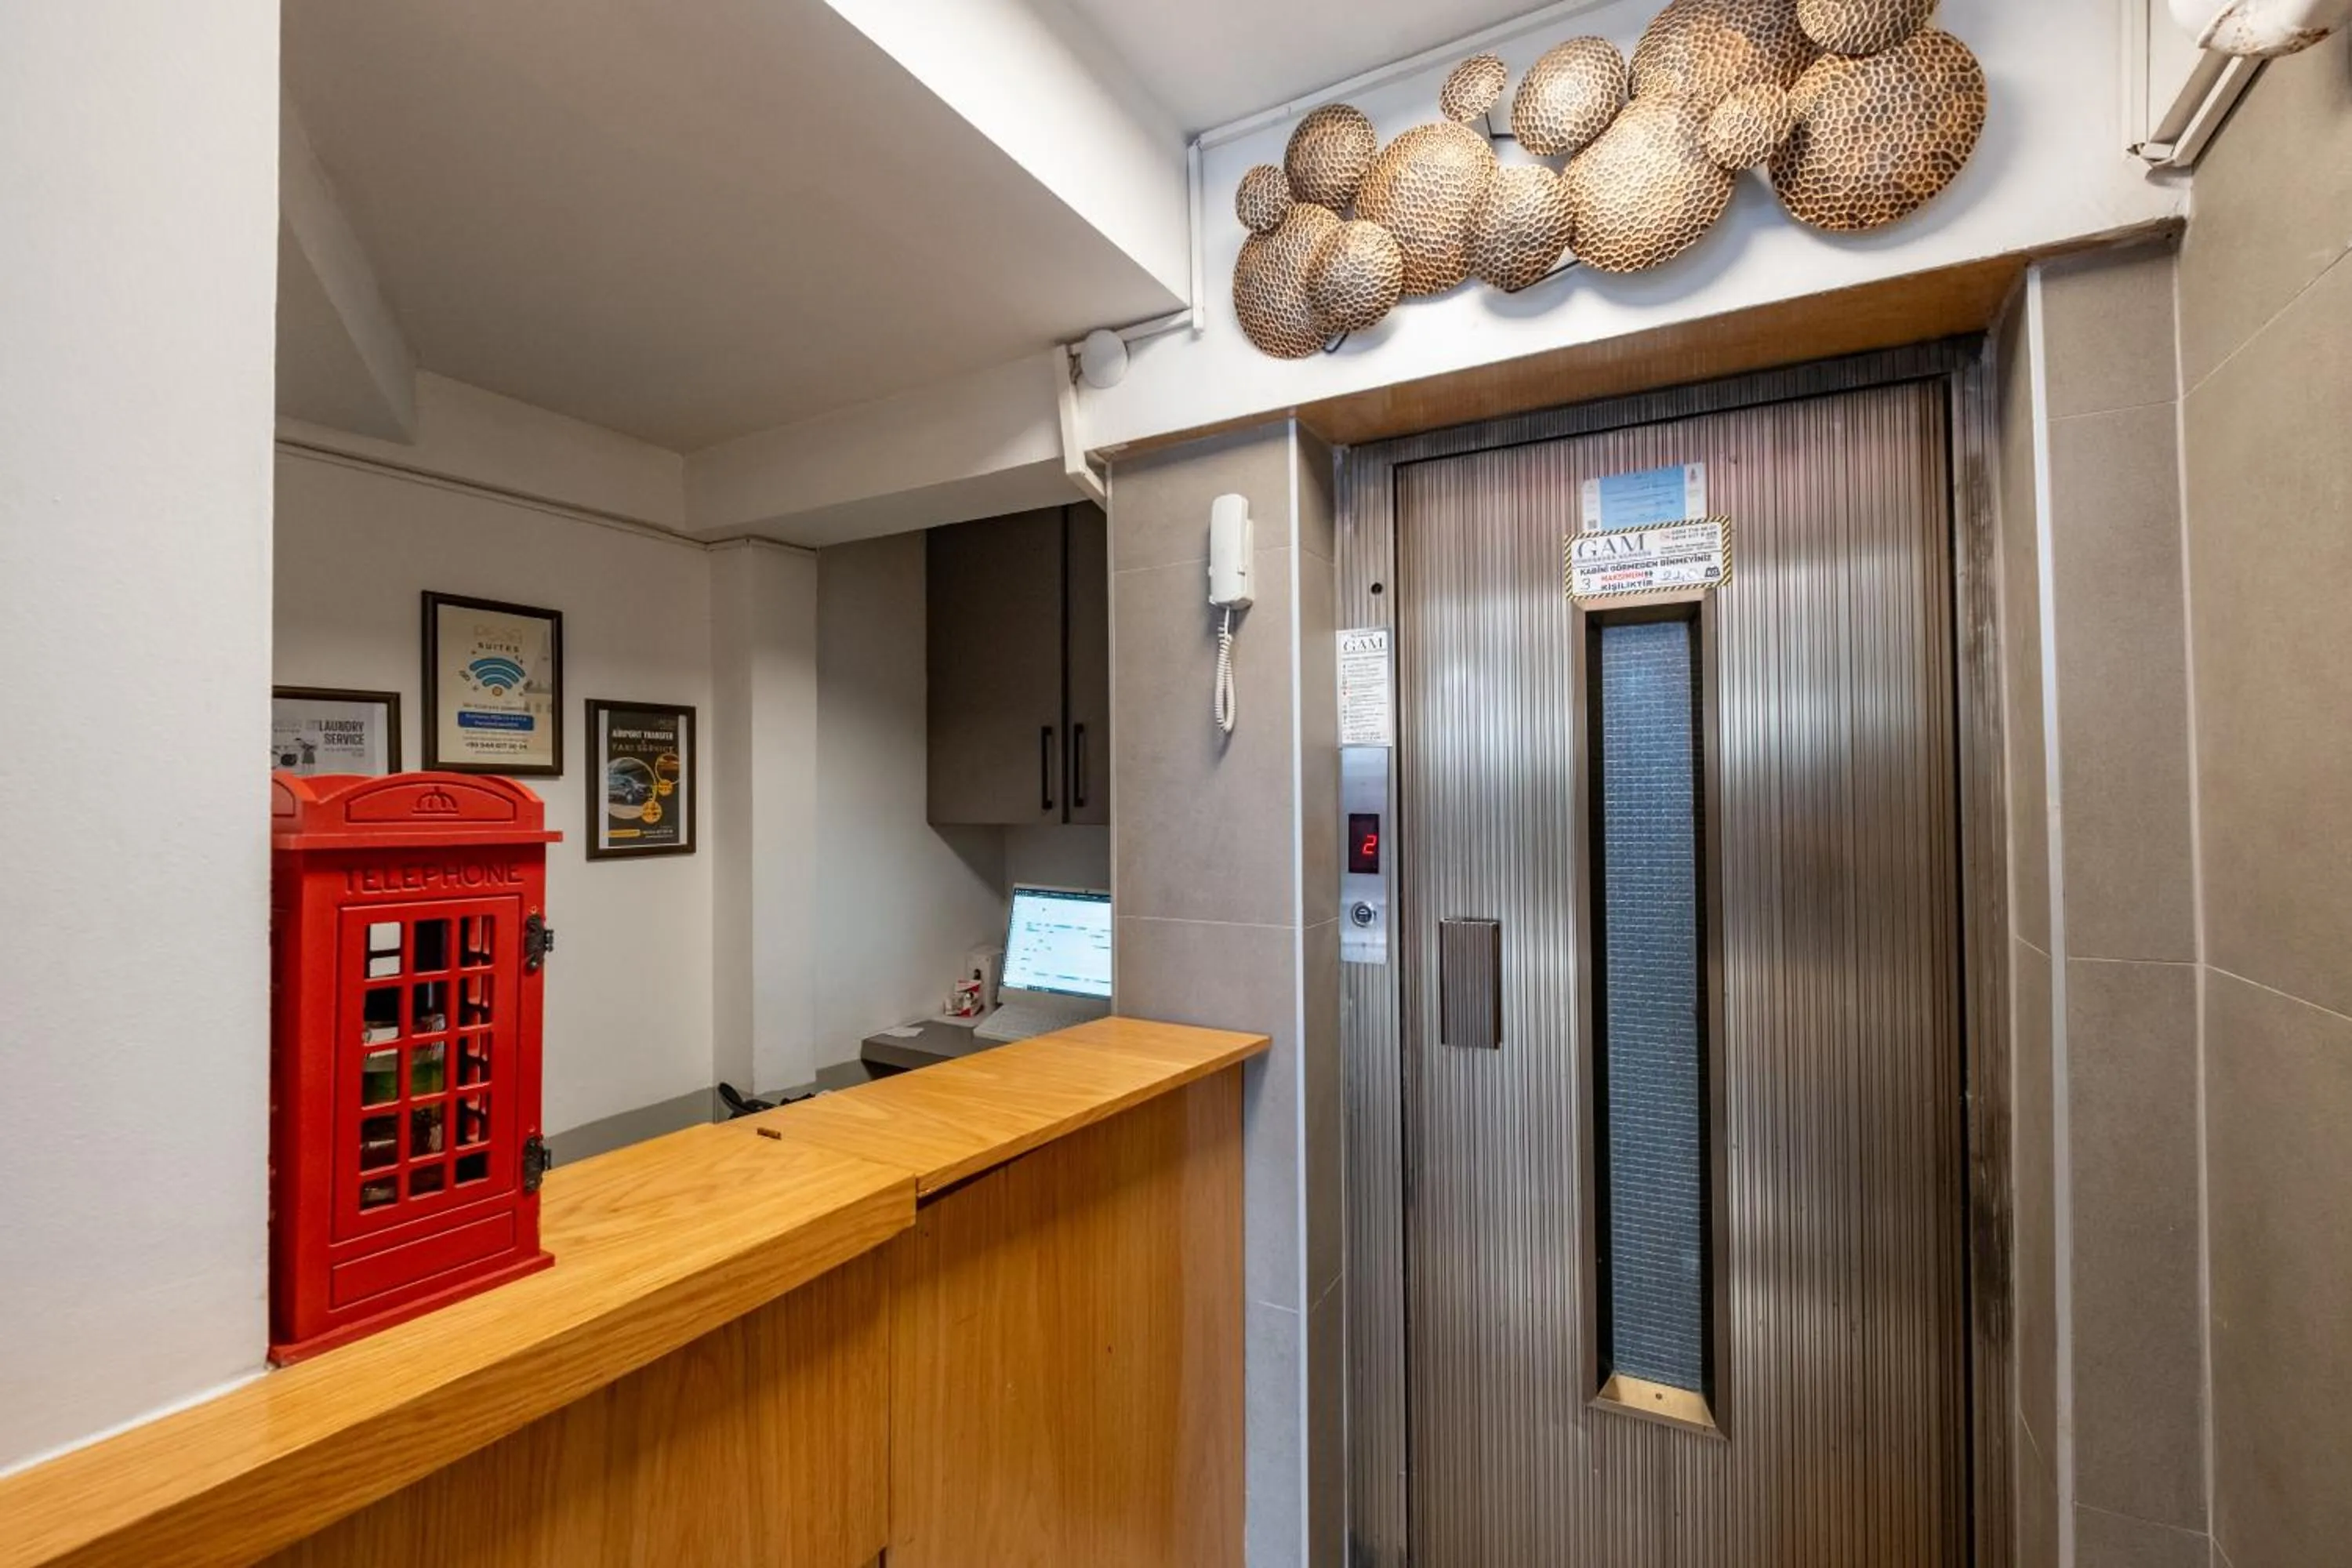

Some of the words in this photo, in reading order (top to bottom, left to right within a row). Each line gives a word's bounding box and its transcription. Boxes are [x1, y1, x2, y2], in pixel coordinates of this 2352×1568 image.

[1577, 534, 1644, 557] GAM
[1343, 637, 1384, 652] GAM
[318, 720, 365, 731] LAUNDRY
[325, 733, 365, 745] SERVICE
[637, 743, 674, 753] SERVICE
[1362, 834, 1377, 855] 2
[342, 861, 524, 895] TELEPHONE
